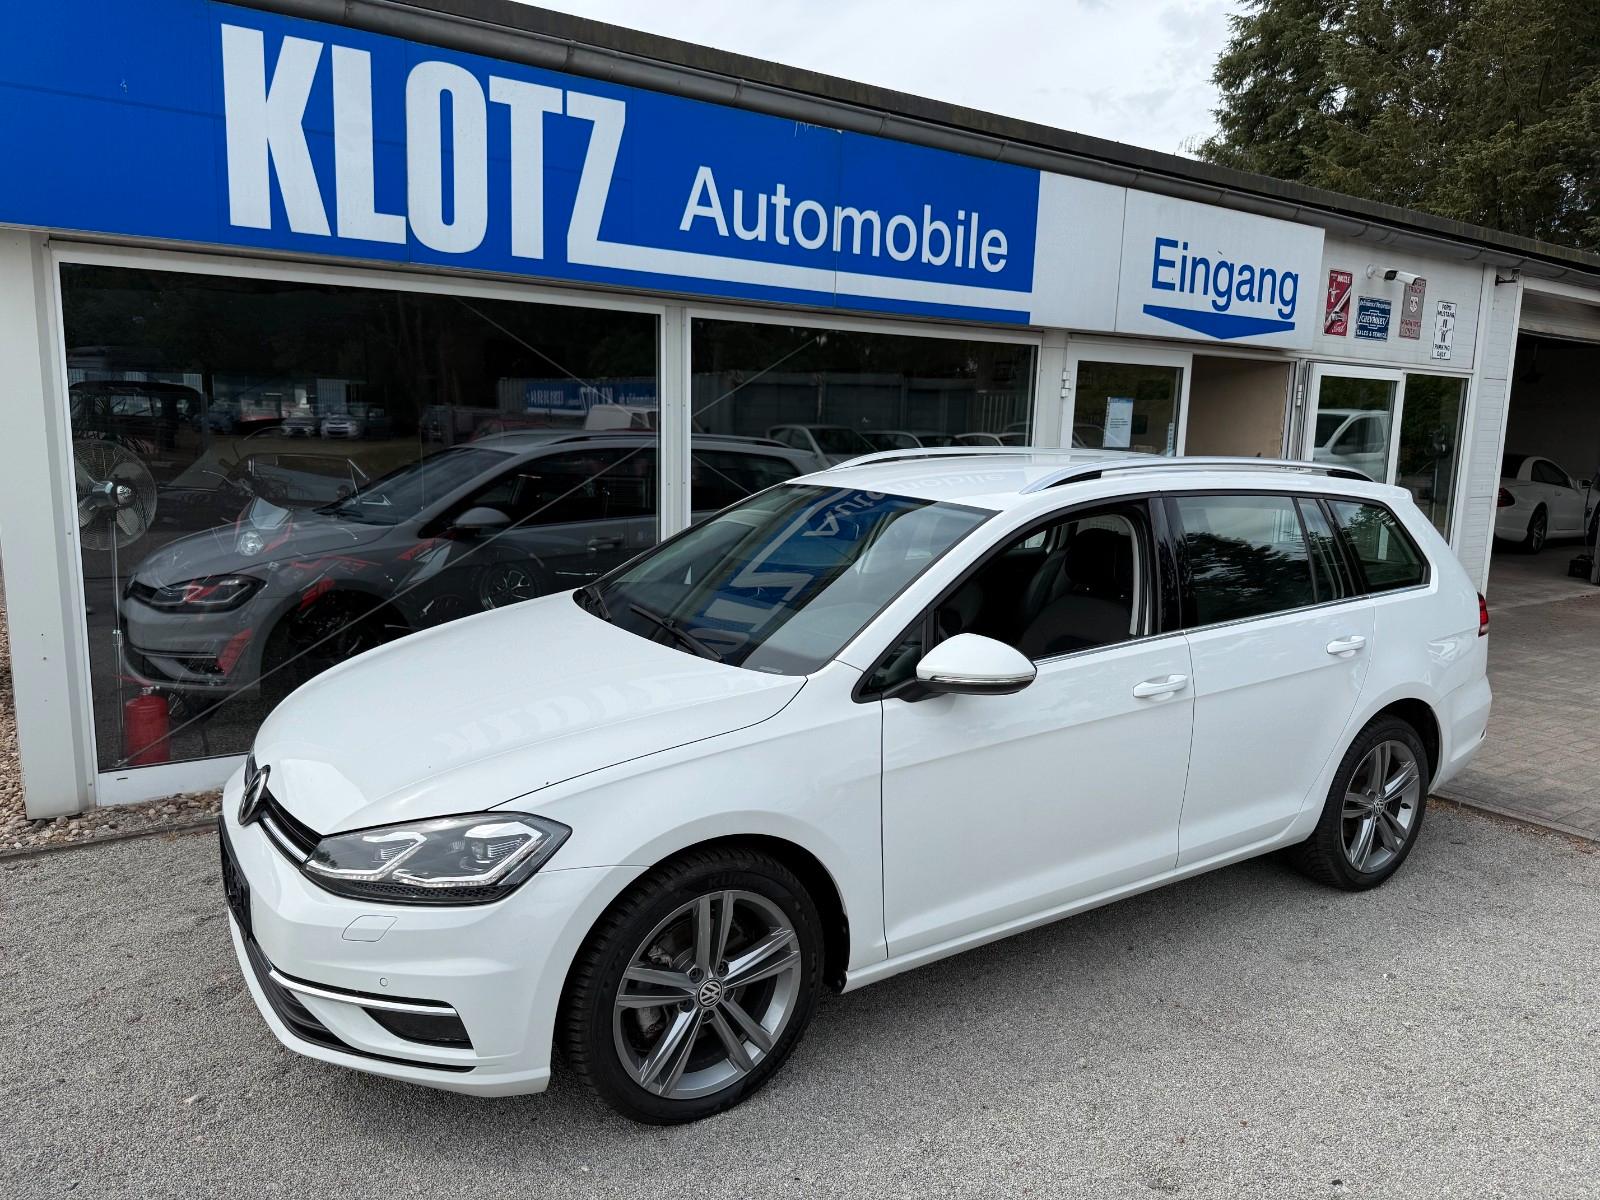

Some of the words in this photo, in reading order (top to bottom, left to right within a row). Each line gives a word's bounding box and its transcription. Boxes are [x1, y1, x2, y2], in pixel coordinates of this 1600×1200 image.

[221, 23, 625, 265] KLOTZ
[680, 166, 1008, 274] Automobile
[1152, 237, 1299, 316] Eingang
